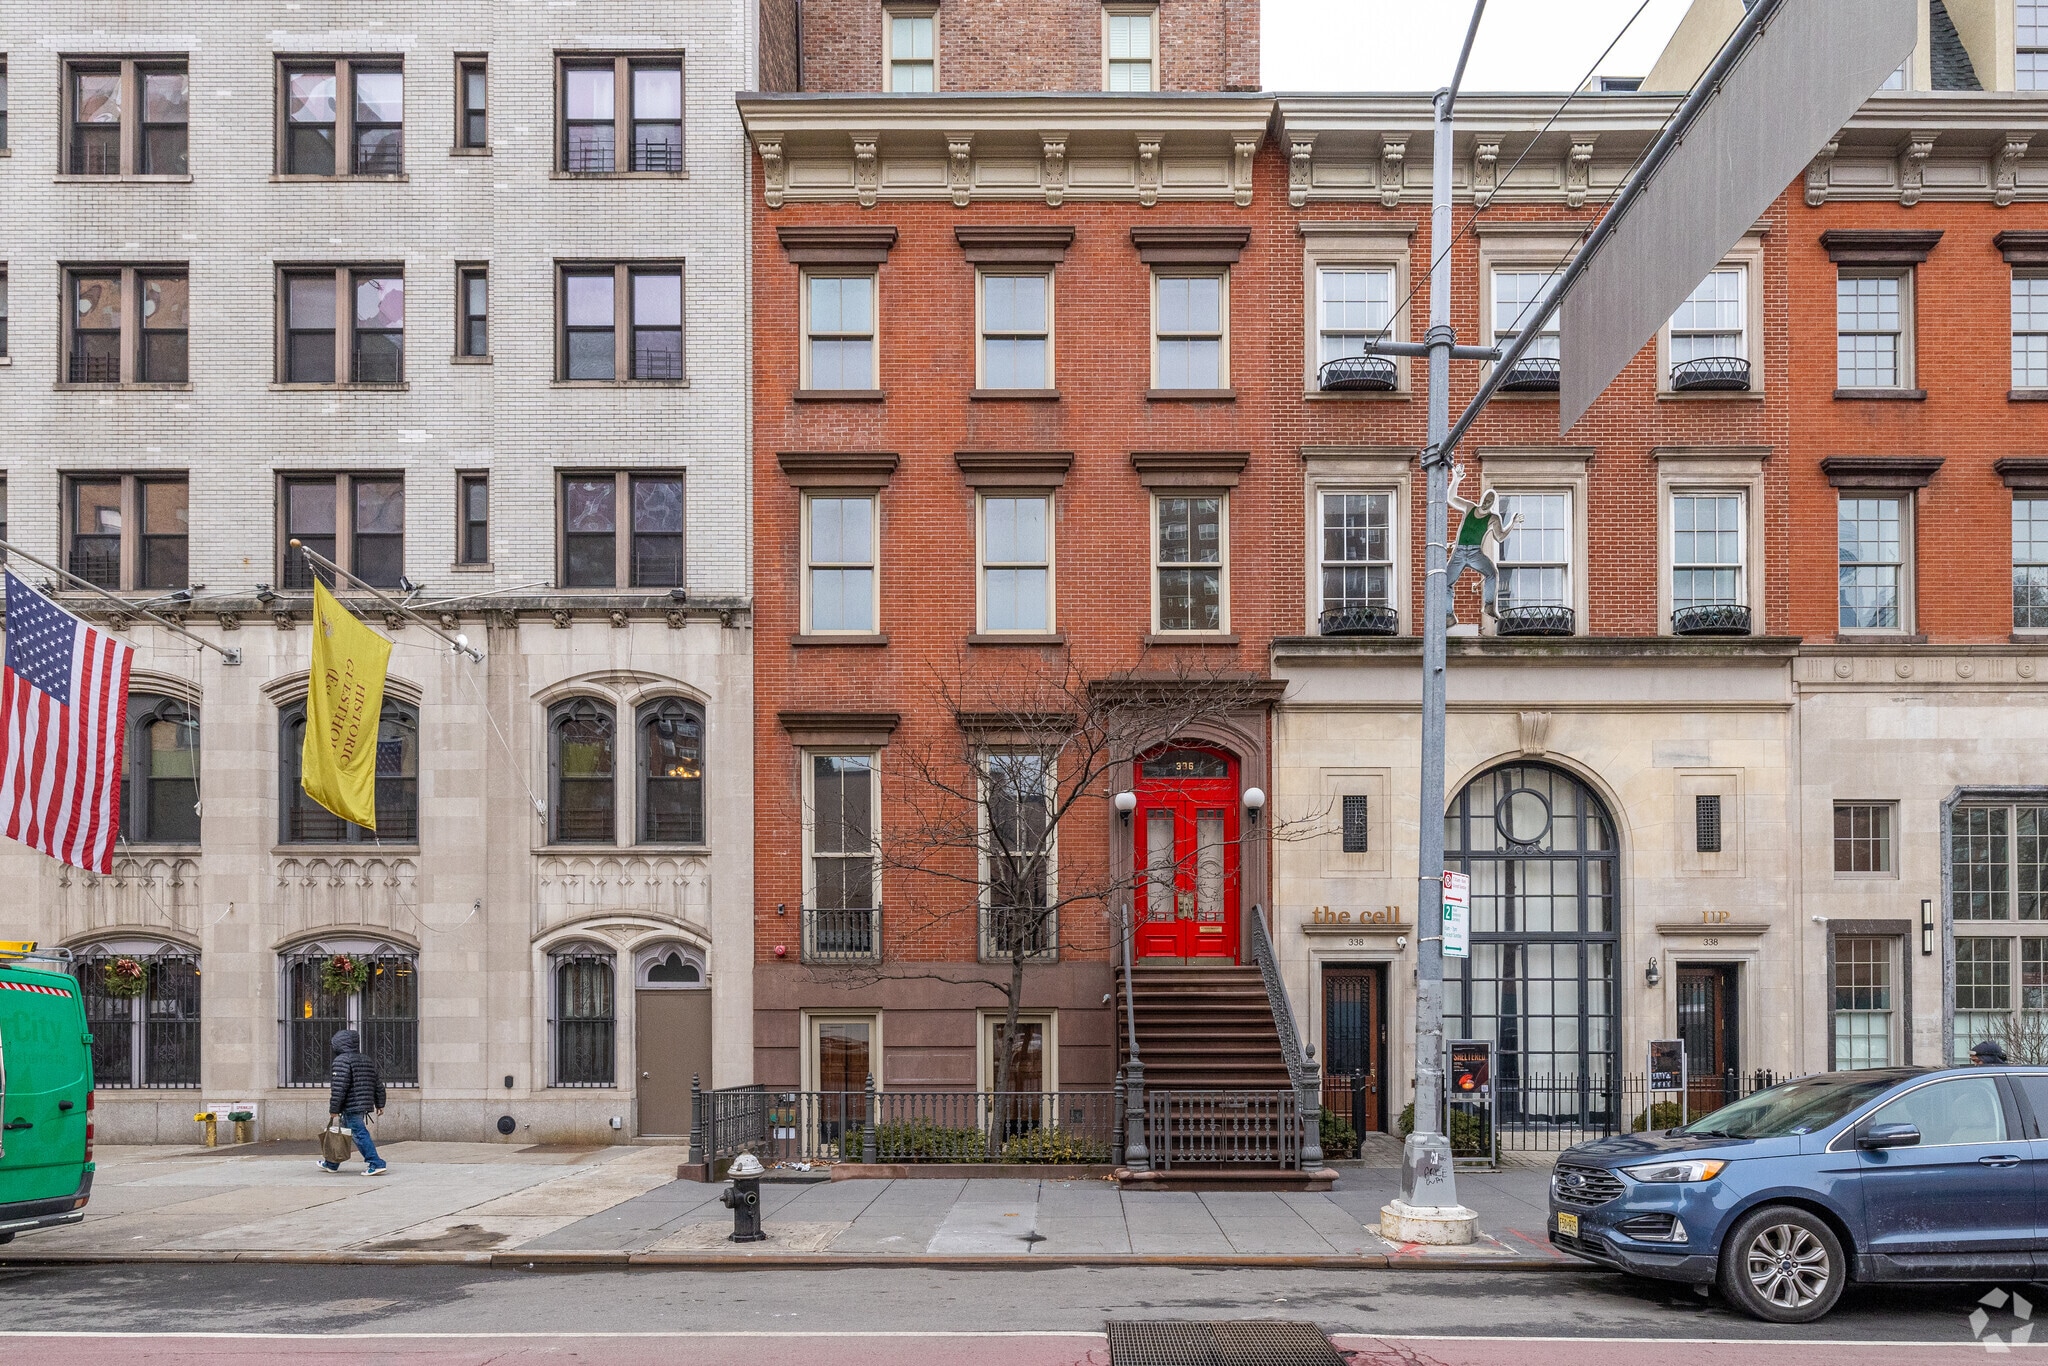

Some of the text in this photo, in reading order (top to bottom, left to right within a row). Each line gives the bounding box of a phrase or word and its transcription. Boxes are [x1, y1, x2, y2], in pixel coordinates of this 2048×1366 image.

[340, 684, 366, 767] HISTORIC
[1176, 762, 1194, 771] 336
[1312, 906, 1400, 924] the cell
[1445, 906, 1451, 919] 2
[1702, 910, 1731, 924] UP
[1348, 938, 1364, 946] 338
[1703, 938, 1719, 946] 338
[1453, 1052, 1486, 1061] SHELTERED
